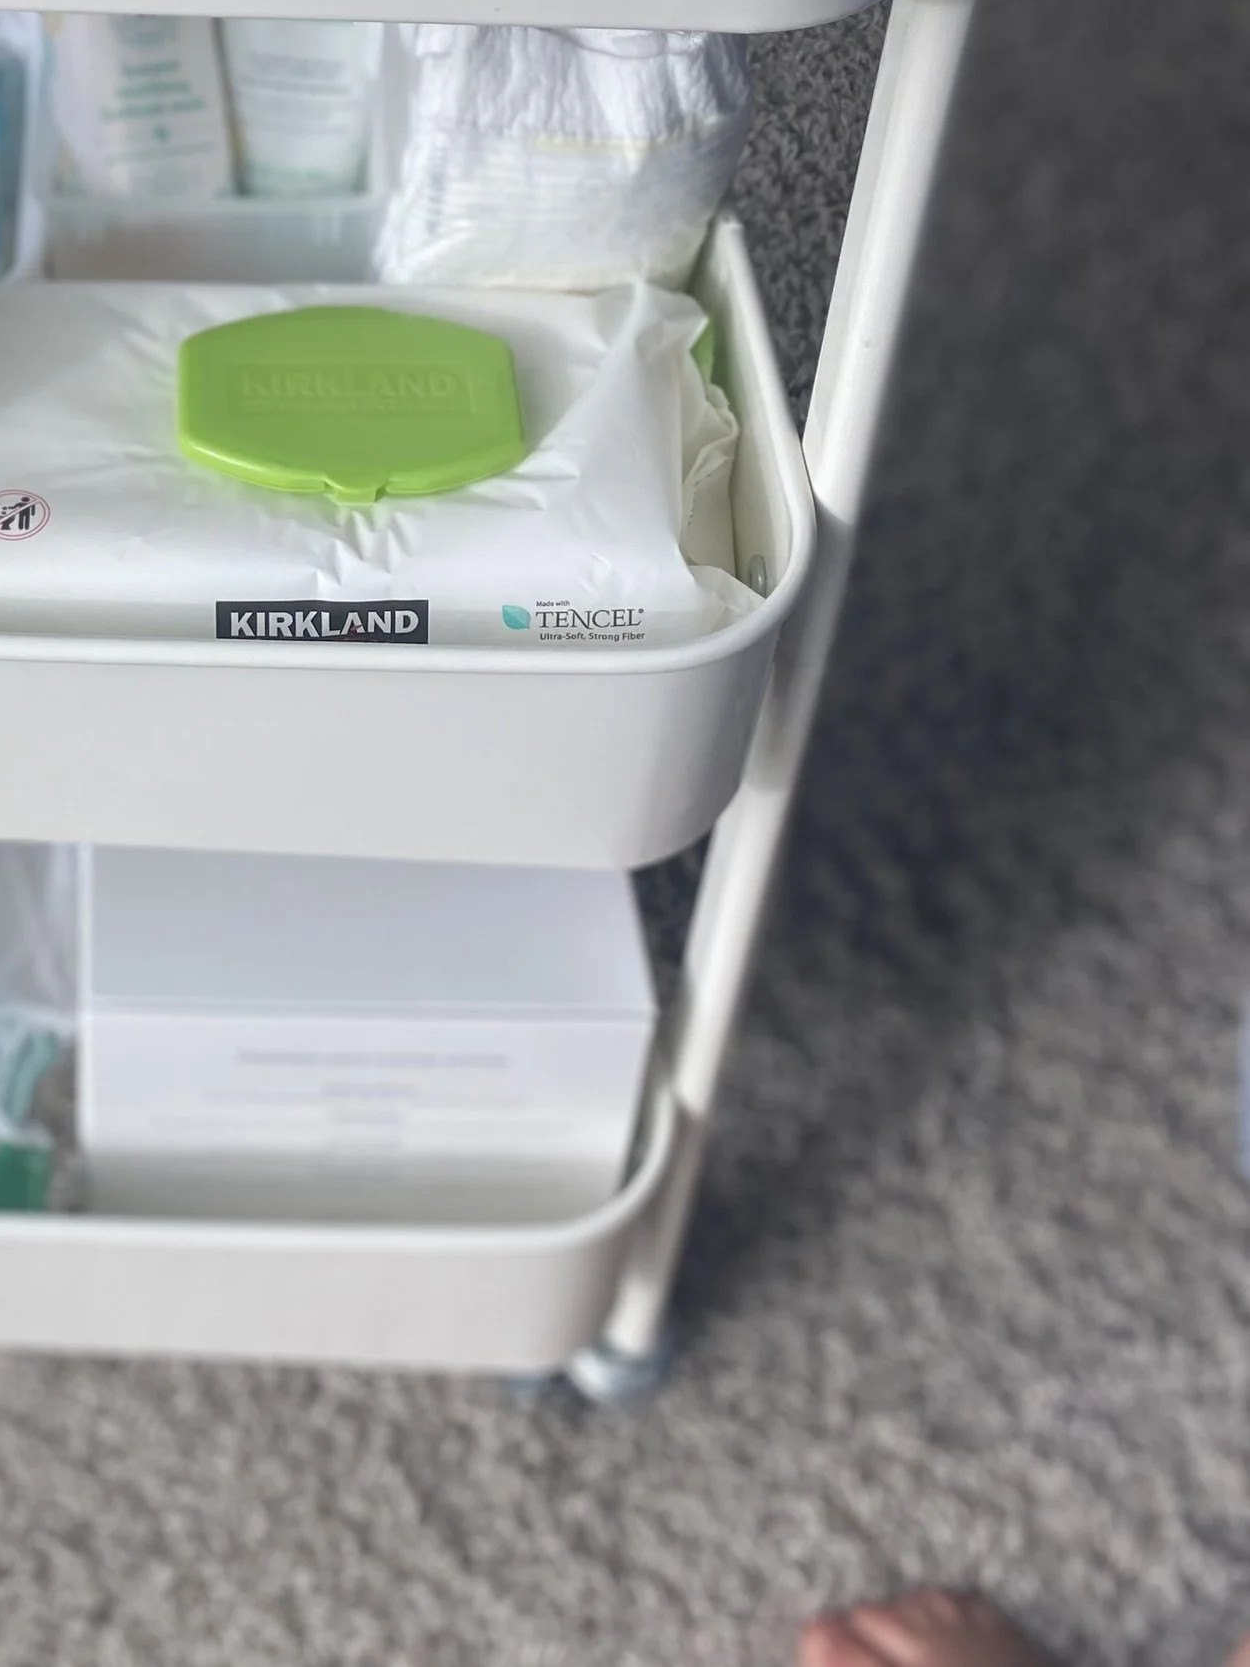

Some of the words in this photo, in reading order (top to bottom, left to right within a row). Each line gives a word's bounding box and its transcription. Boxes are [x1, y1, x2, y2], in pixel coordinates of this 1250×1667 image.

[230, 609, 420, 637] KIRKLAND
[536, 609, 642, 630] TENCEL
[589, 633, 619, 642] Strong
[622, 632, 645, 641] Fiber
